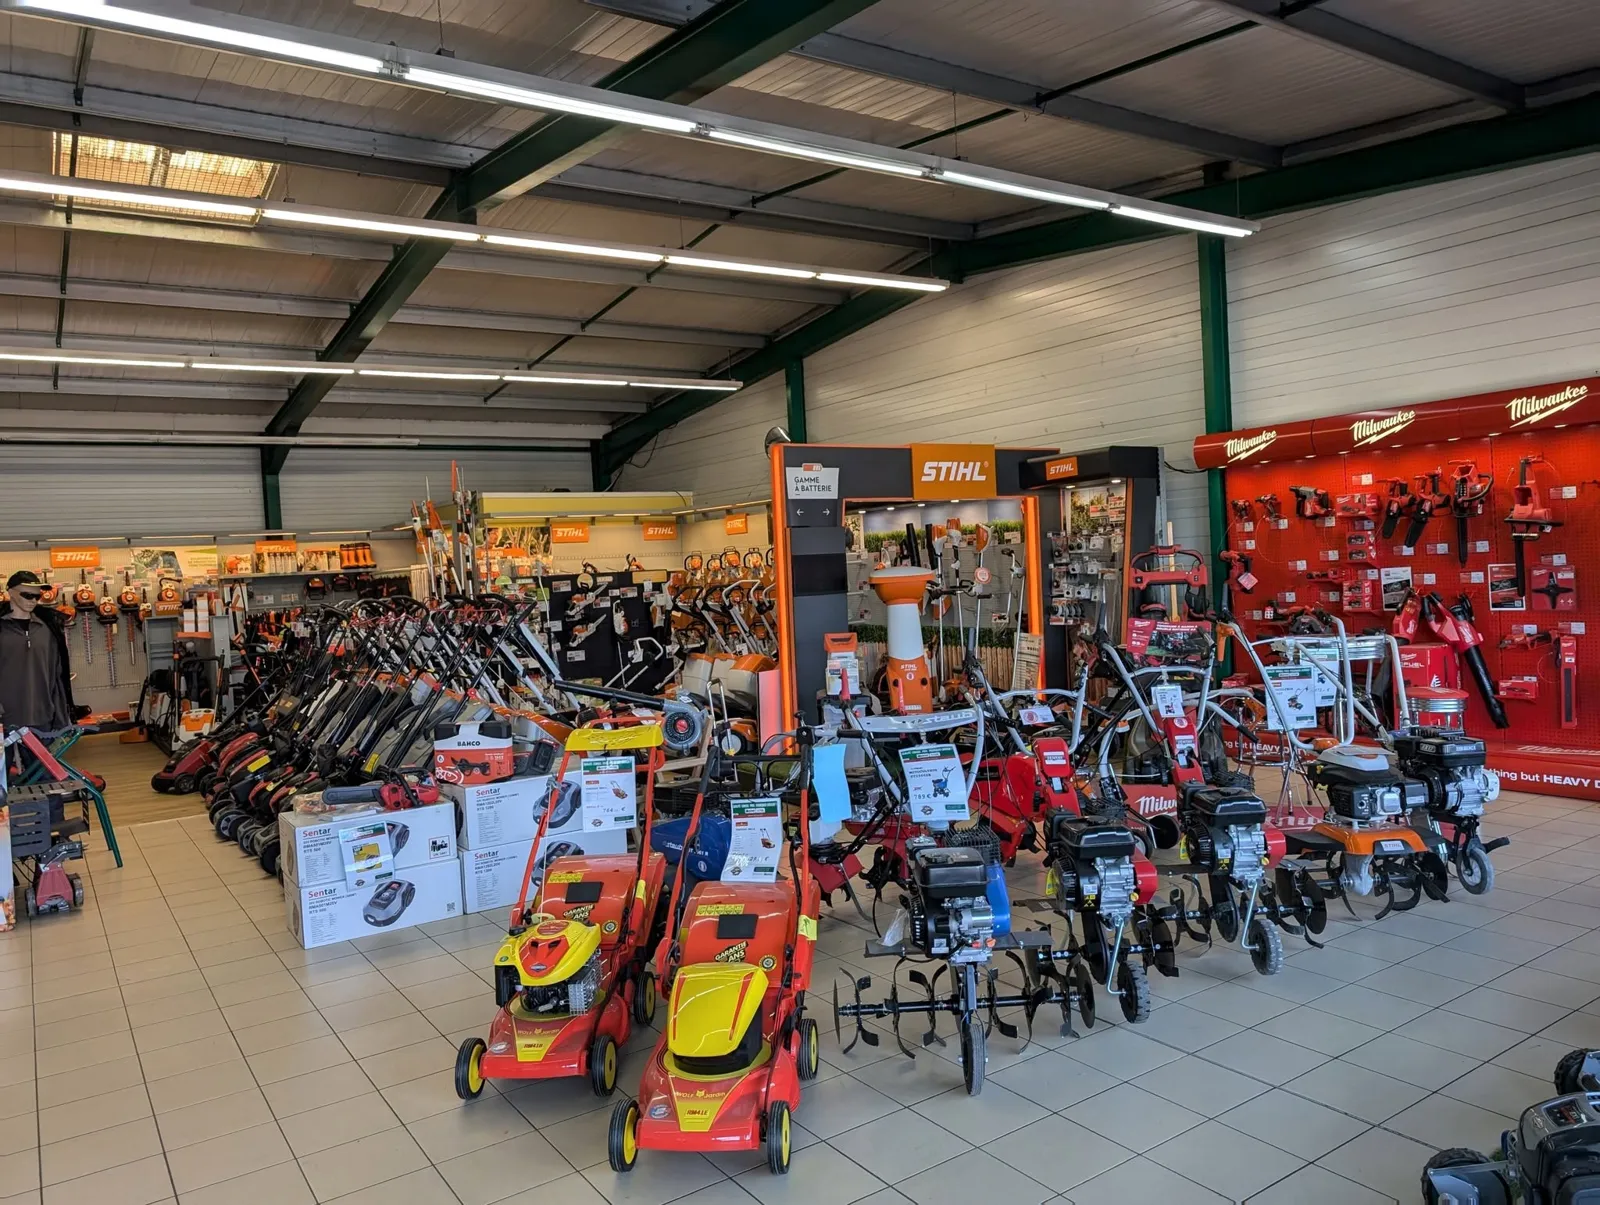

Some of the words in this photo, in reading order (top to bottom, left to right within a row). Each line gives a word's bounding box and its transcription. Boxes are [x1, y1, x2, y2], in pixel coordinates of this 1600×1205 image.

[1505, 384, 1588, 421] Milwaukee
[1349, 410, 1416, 442] Milwaukee
[1223, 429, 1277, 458] Milwaukee
[920, 461, 987, 482] STIHL
[1049, 463, 1075, 475] STIHL
[794, 476, 820, 484] GAMME
[800, 484, 832, 492] BATTERIE
[726, 519, 745, 528] STIHL
[555, 528, 584, 537] STIHL
[647, 526, 674, 535] STIHL
[55, 552, 94, 562] STIHL
[1520, 771, 1541, 783] but
[1543, 774, 1591, 788] HEAVY
[476, 788, 500, 797] Sentar
[302, 827, 332, 838] Sentar
[474, 850, 499, 860] Sentar
[308, 888, 337, 898] Sentar
[728, 949, 746, 963] ANS
